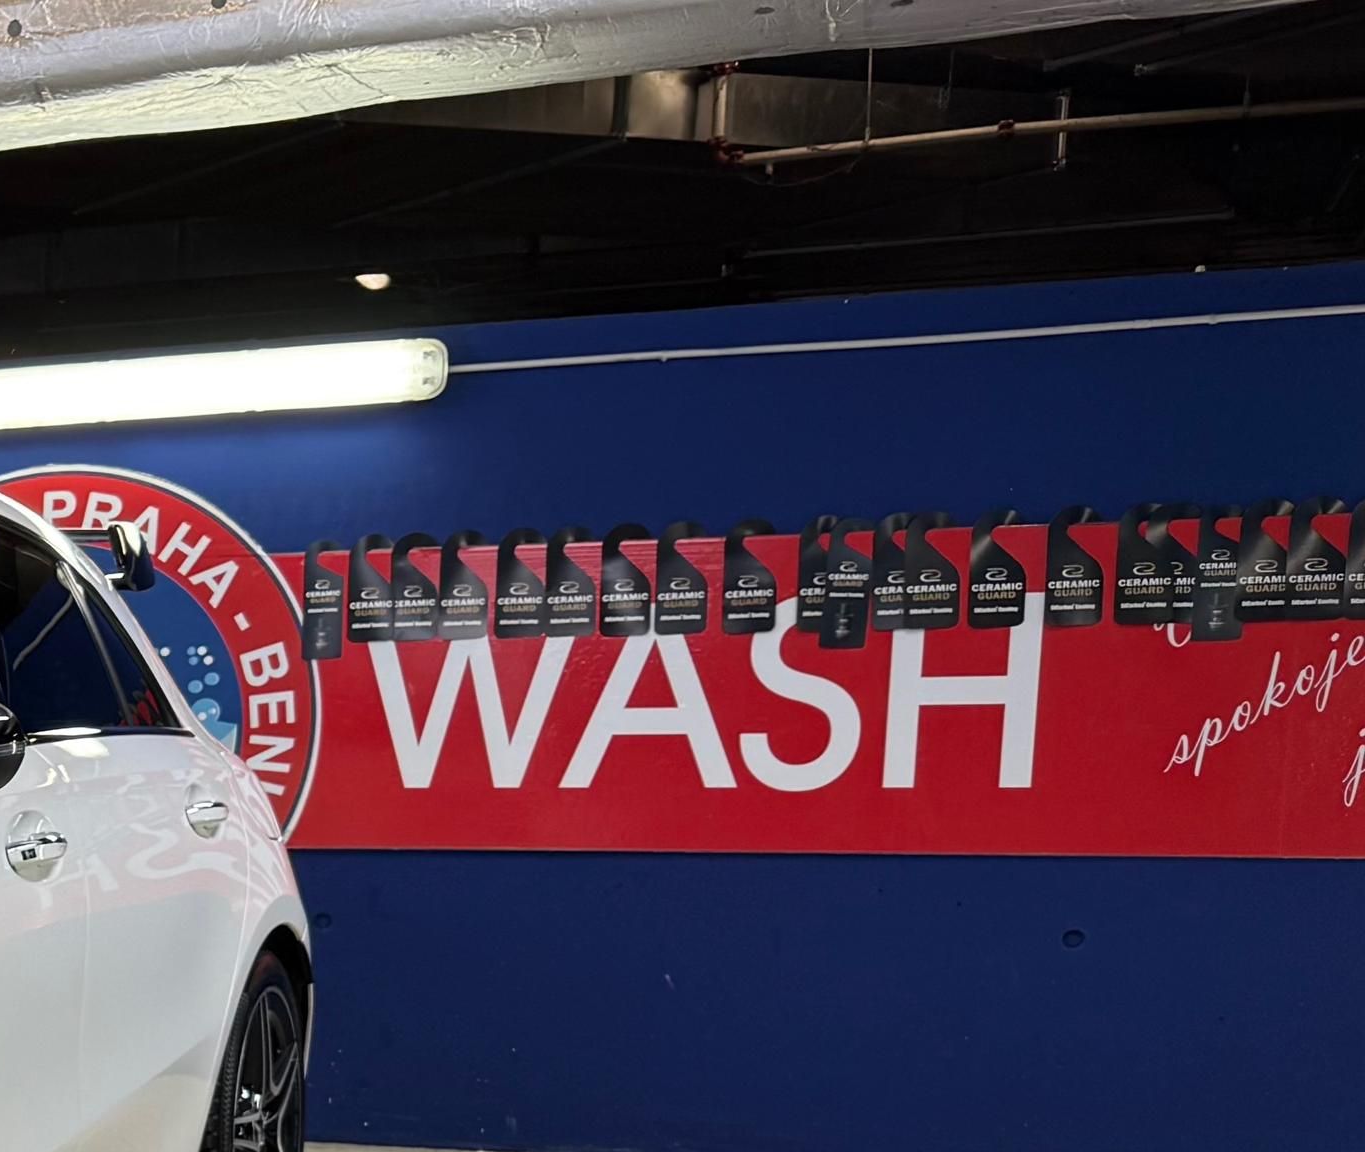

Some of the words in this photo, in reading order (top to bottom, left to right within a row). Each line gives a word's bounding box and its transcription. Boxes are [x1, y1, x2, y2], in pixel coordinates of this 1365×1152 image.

[828, 573, 869, 581] CERAMIC
[1118, 577, 1171, 587] CERAMIC
[1289, 573, 1345, 583] CERAMIC
[906, 584, 957, 594] CERAMIC
[971, 582, 1023, 592] CERAMIC
[1048, 579, 1101, 589] CERAMIC
[1295, 583, 1337, 592] GUARD
[725, 588, 774, 599] CERAMIC
[977, 591, 1016, 600] GUARD
[1054, 588, 1093, 597] GUARD
[1124, 586, 1165, 595] GUARD
[497, 596, 543, 605] CERAMIC
[547, 594, 593, 605] CERAMIC
[601, 592, 649, 603] CERAMIC
[657, 591, 705, 601] CERAMIC
[912, 592, 951, 601] GUARD
[349, 600, 393, 610] CERAMIC
[441, 598, 485, 607] CERAMIC
[368, 592, 1045, 792] WASH
